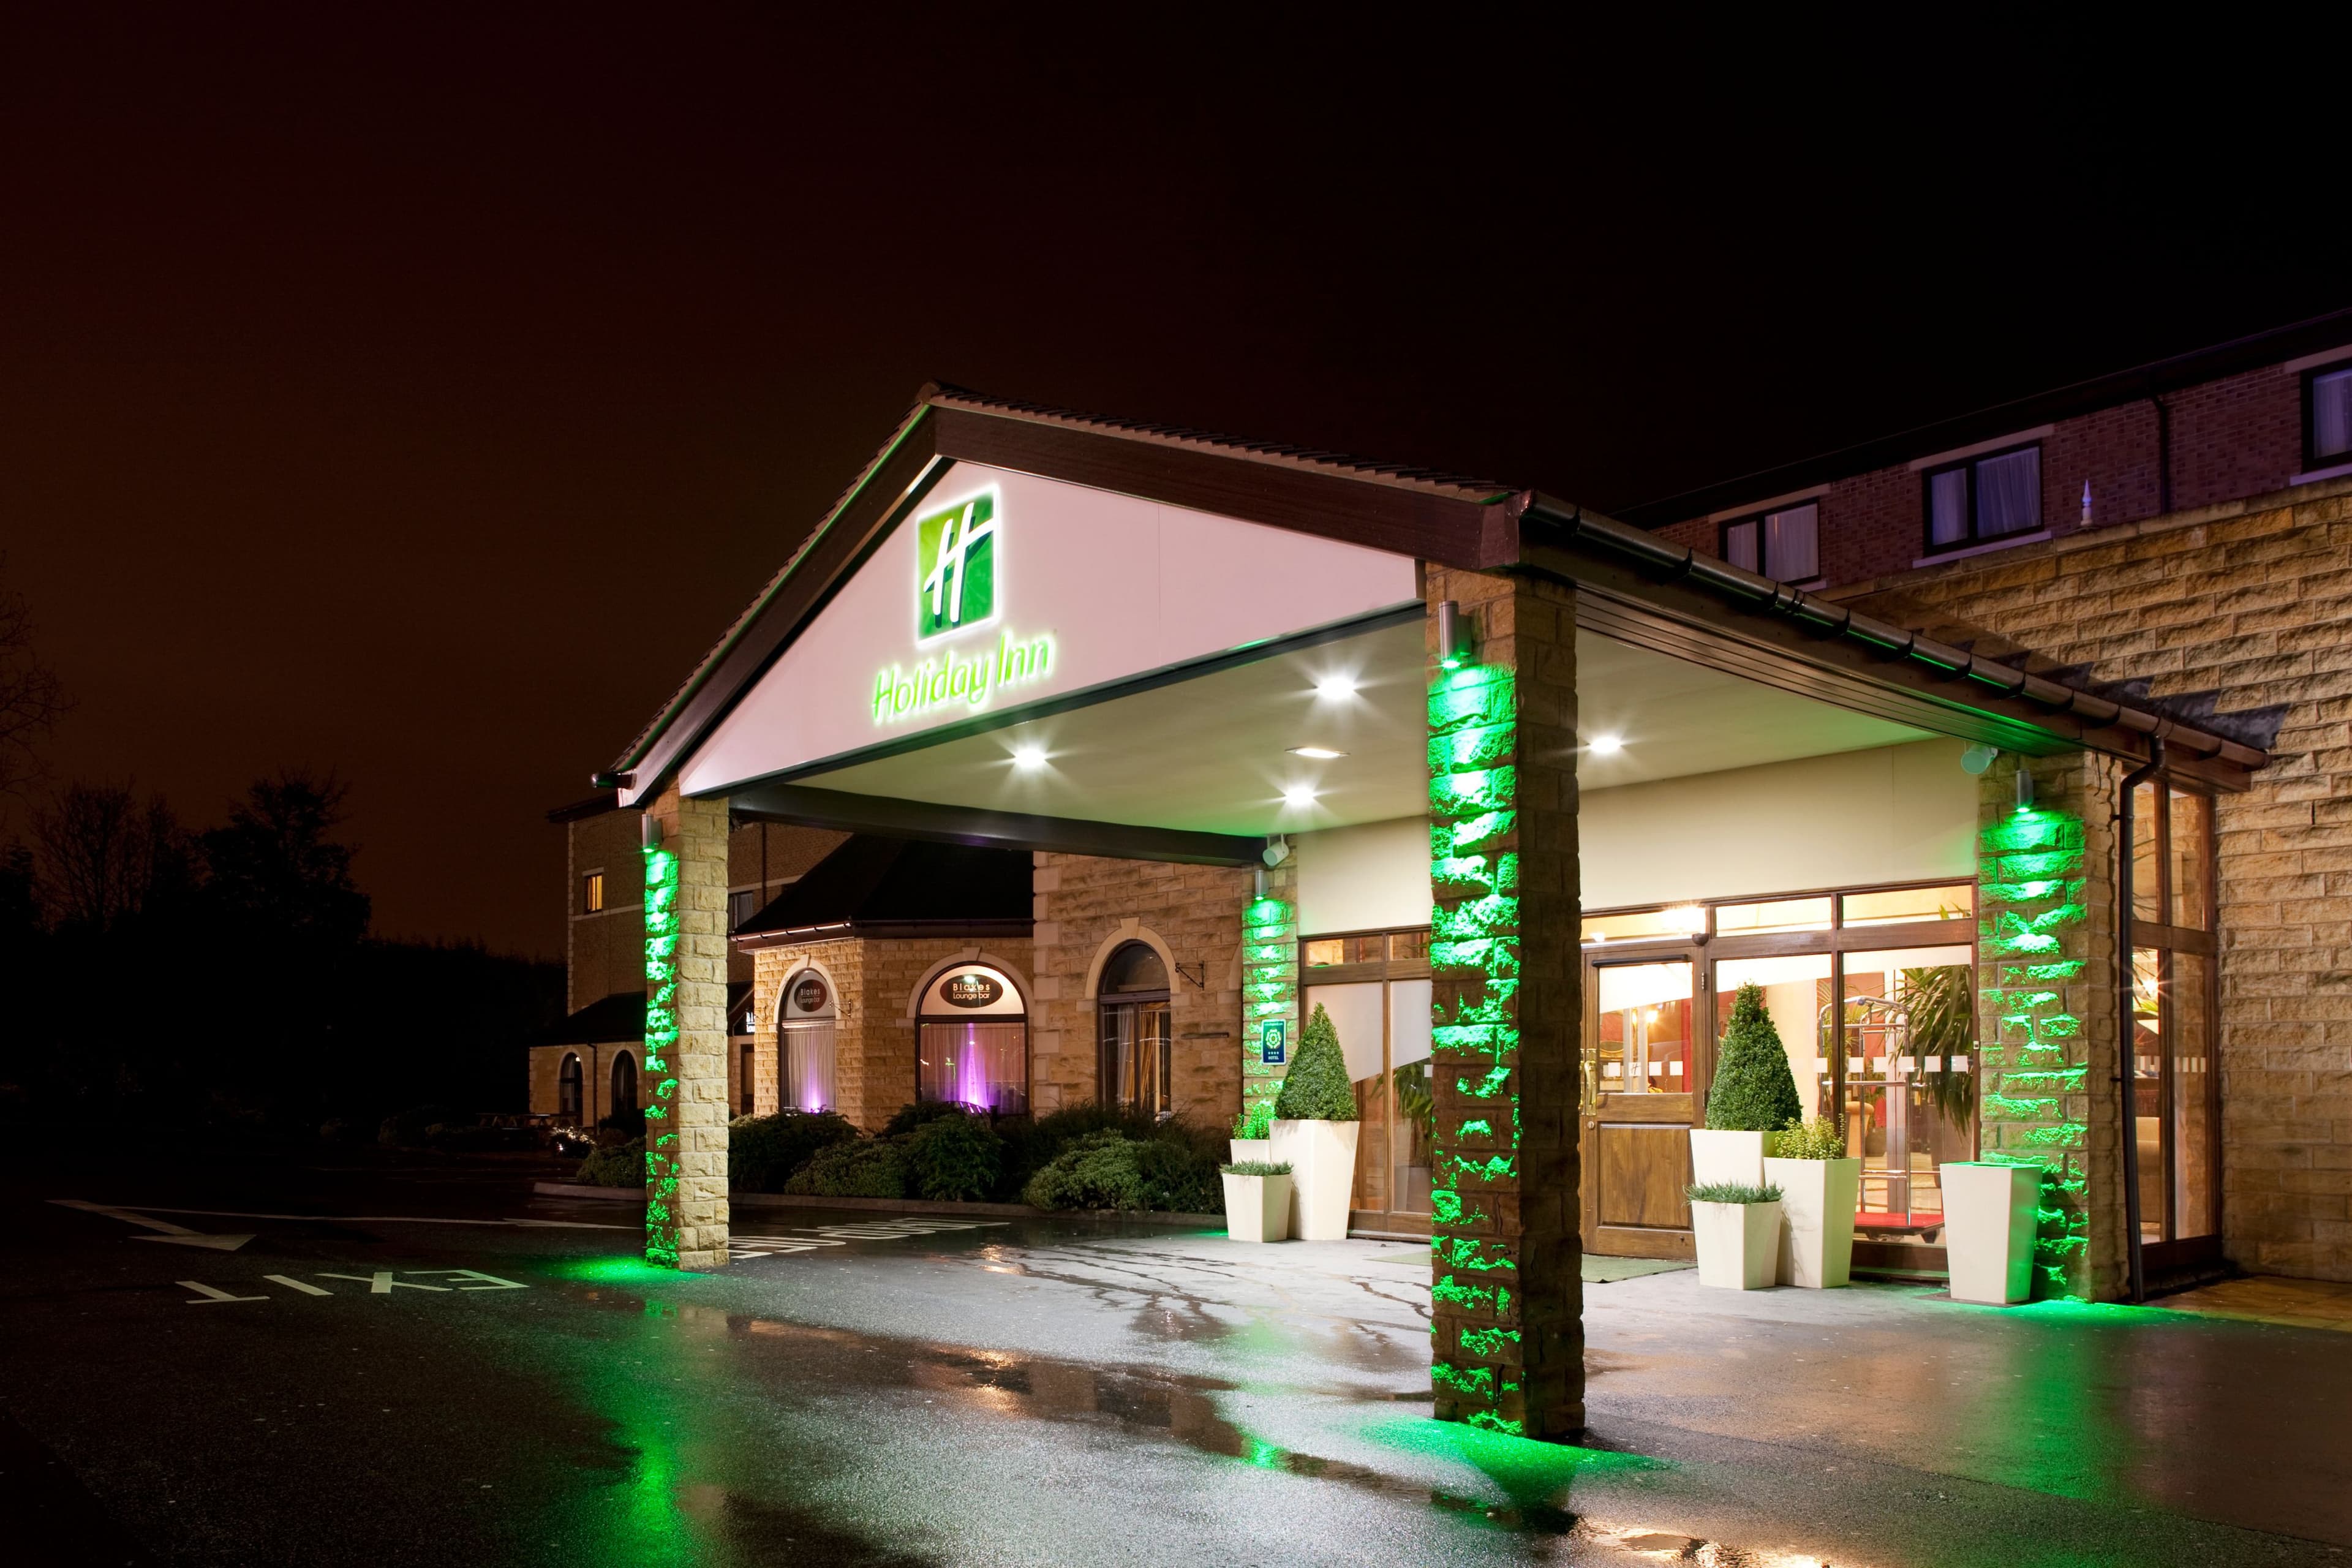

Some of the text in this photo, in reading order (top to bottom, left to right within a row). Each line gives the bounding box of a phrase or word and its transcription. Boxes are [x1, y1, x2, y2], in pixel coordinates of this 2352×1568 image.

[873, 631, 1052, 722] Holiday Inn
[791, 1217, 1011, 1239] DROP
[175, 1269, 529, 1304] EXIT
